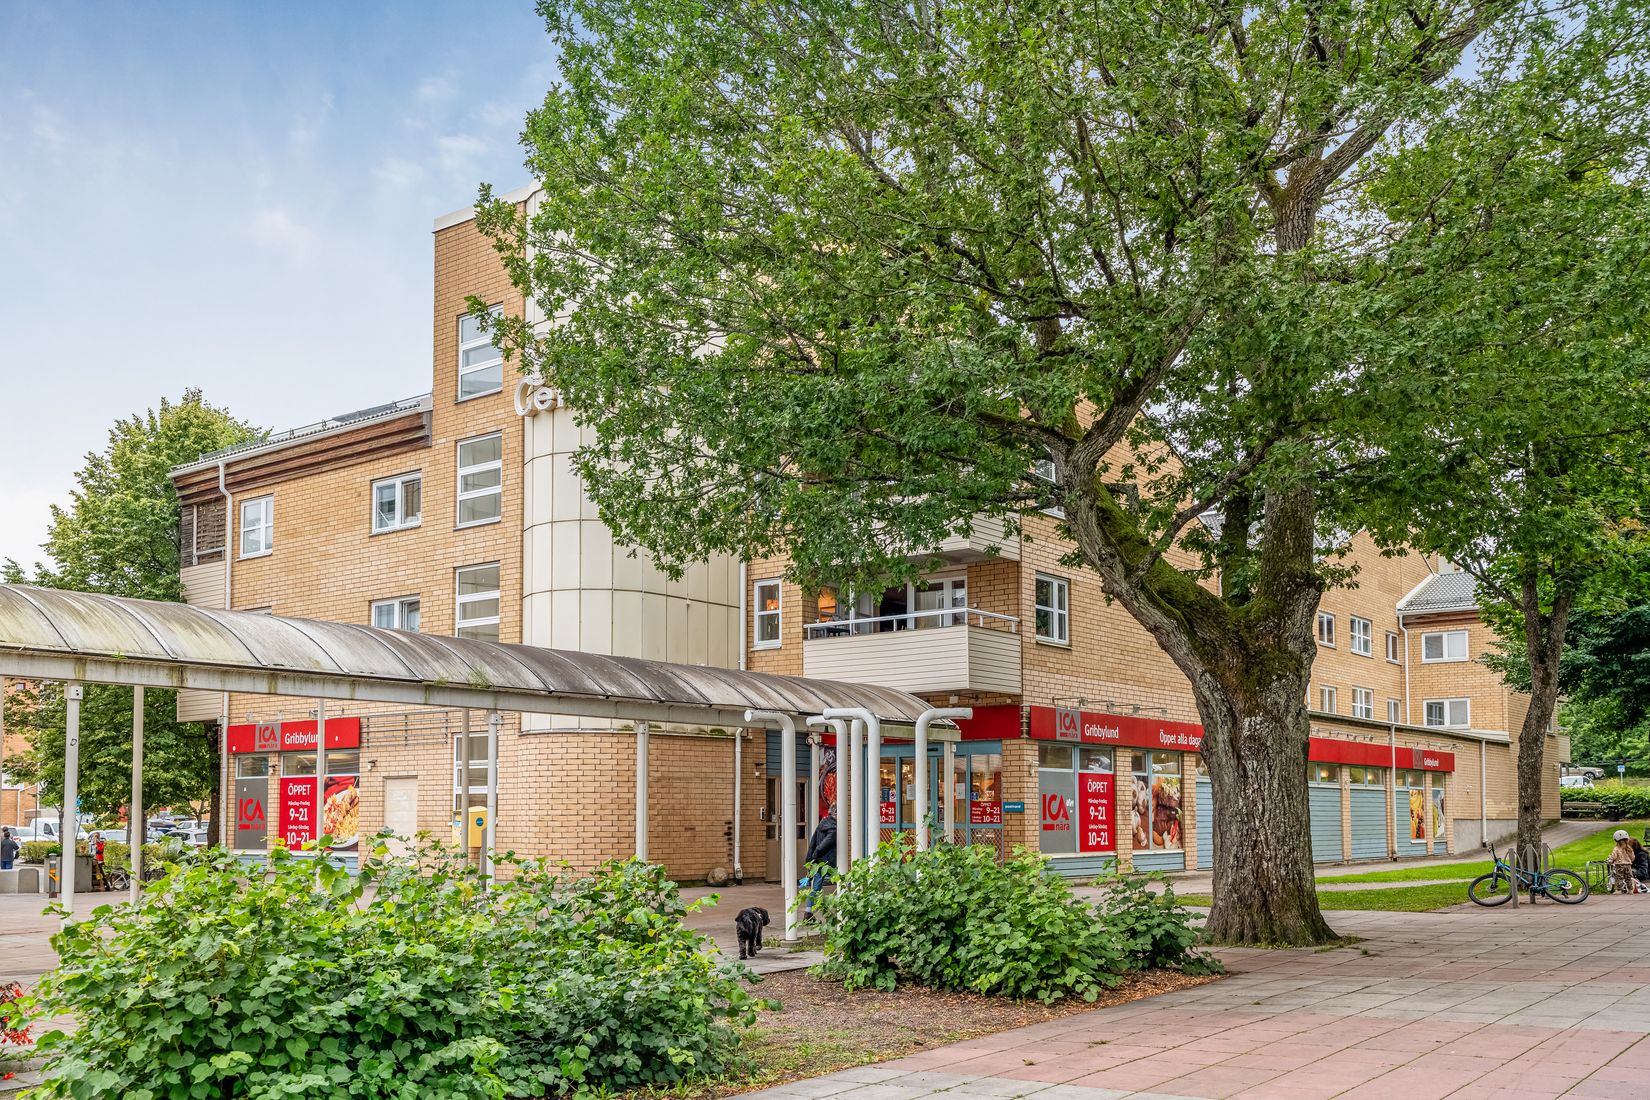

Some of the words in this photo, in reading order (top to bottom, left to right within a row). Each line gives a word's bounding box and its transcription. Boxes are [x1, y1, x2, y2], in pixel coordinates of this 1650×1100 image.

[1059, 711, 1077, 731] ICA
[258, 726, 277, 743] ICA
[1084, 723, 1119, 740] Gribbylund
[1159, 729, 1176, 746] Öppet
[1177, 733, 1188, 745] alla
[1188, 734, 1202, 748] daga
[287, 782, 311, 796] ÖPPET
[1087, 779, 1108, 793] ÖPPET
[239, 798, 266, 822] ICA
[289, 807, 309, 821] 9-21
[985, 806, 1001, 814] 9-21
[1042, 793, 1069, 821] ICA
[1089, 805, 1107, 820] 9-21
[982, 815, 1001, 823] 10-21
[1055, 821, 1071, 832] nära
[1088, 831, 1109, 846] 10-21
